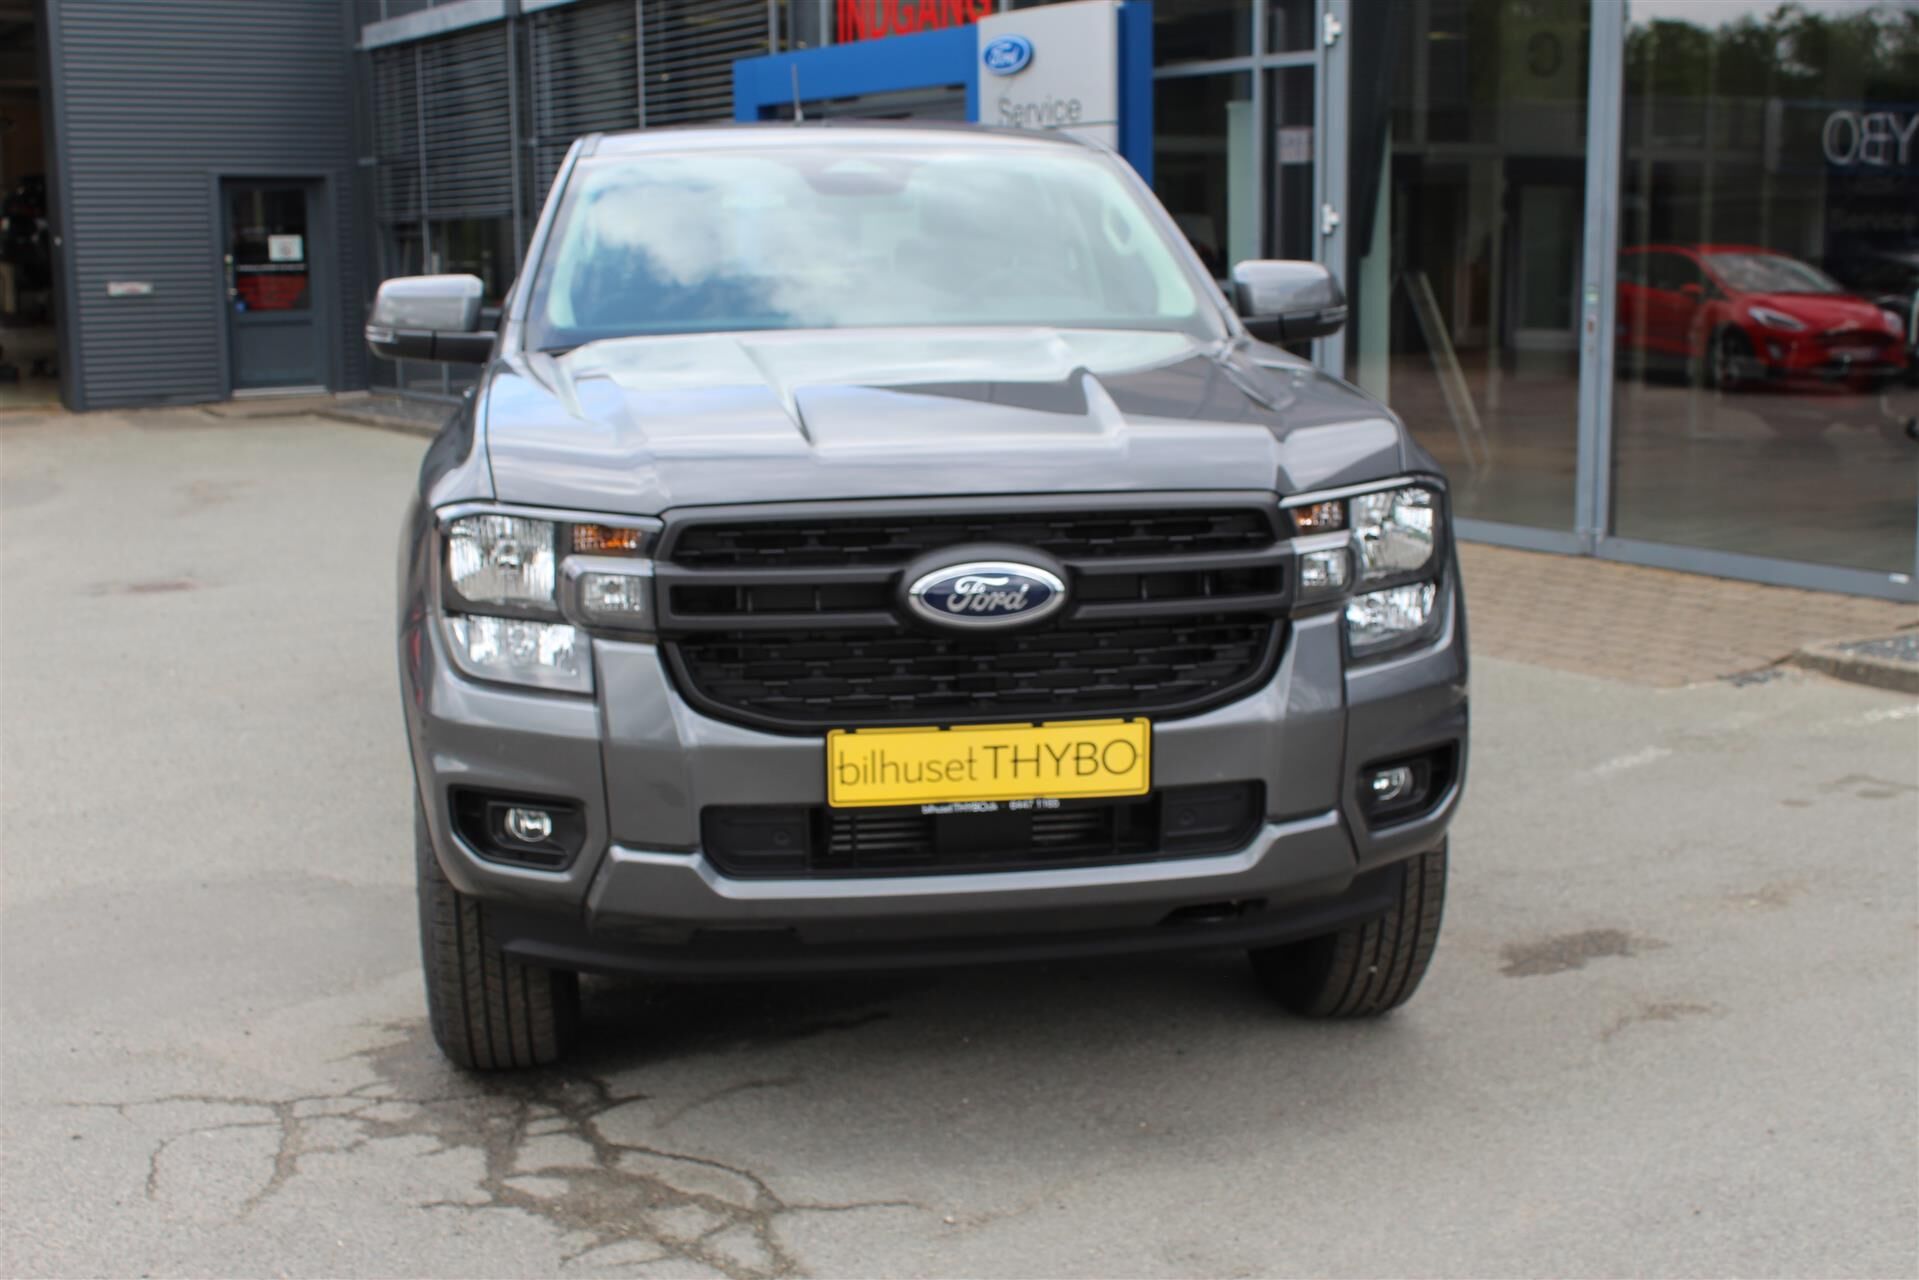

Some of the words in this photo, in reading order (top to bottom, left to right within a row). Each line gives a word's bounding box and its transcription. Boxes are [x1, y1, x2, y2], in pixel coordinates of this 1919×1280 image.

[997, 91, 1083, 126] Service
[946, 575, 1029, 612] Ford
[837, 746, 979, 786] bilhuset
[982, 738, 1140, 780] THYBO
